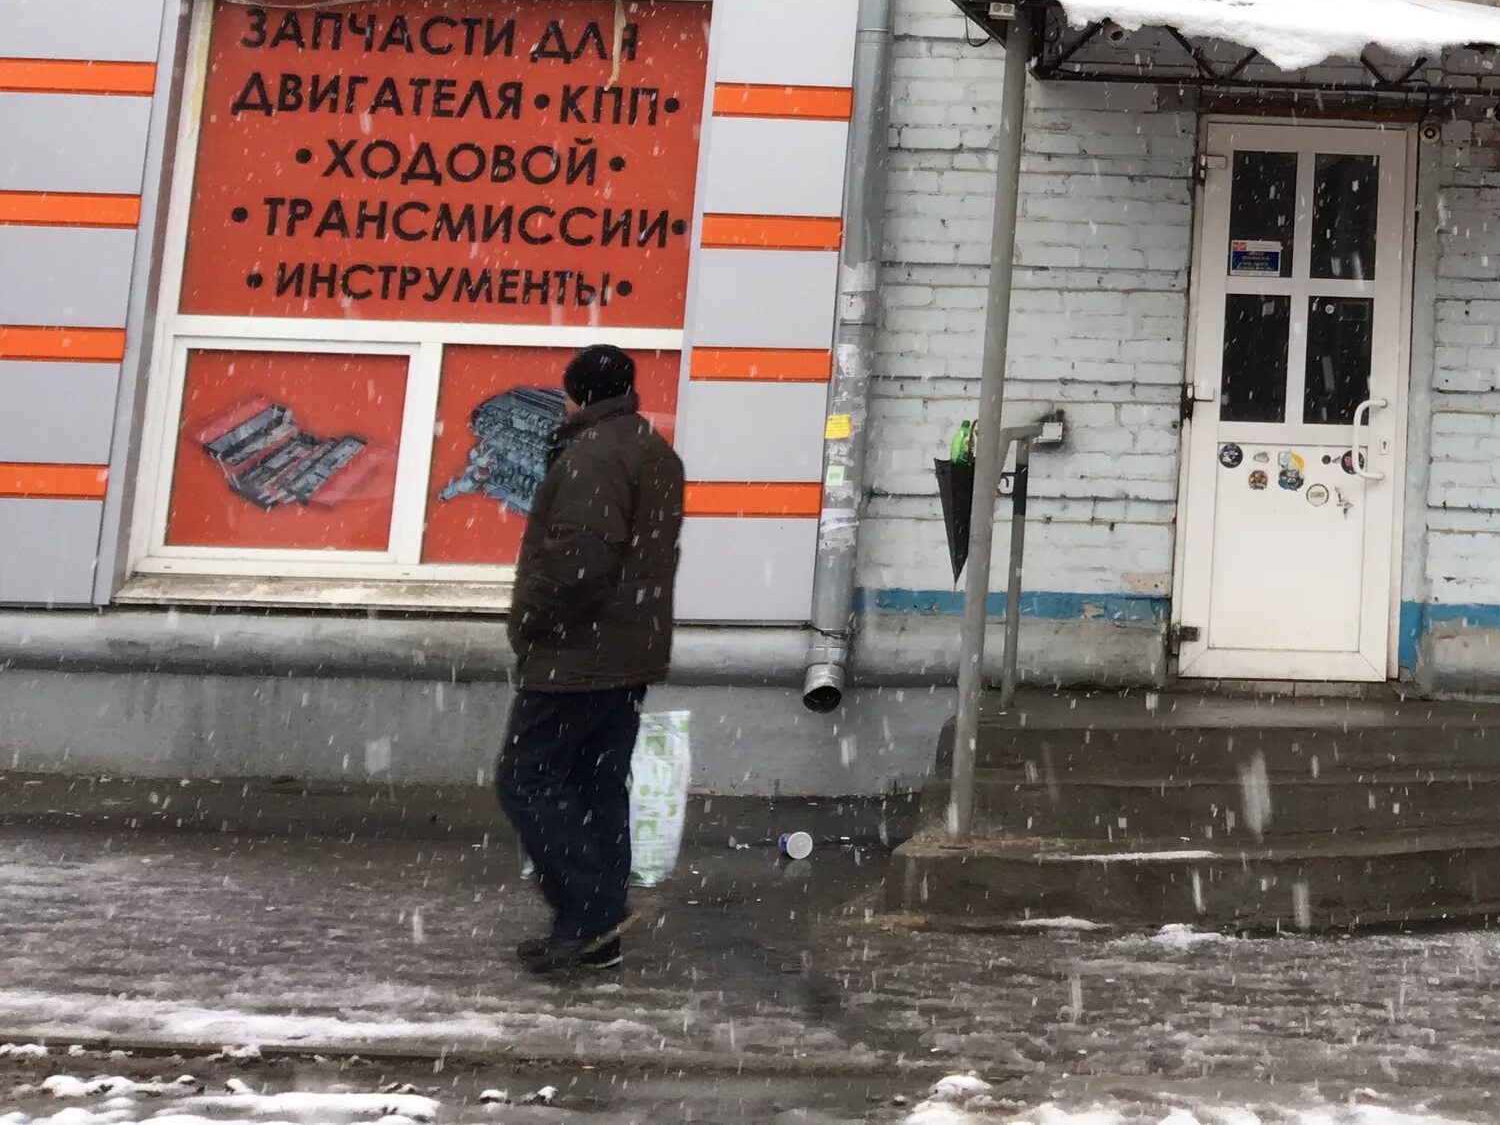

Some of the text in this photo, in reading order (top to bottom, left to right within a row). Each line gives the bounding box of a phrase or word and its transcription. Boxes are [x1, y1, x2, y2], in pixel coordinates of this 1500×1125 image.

[241, 7, 639, 64] ЗАПЧАСТИ ДЛЯ
[230, 72, 660, 126] ДВИГАТЕЛЯ КПП
[321, 137, 598, 187] ХОДОВОЙ
[263, 197, 670, 249] ТРАНСМИССИИ
[275, 262, 609, 307] ИНСТРУМЕНТЫ
